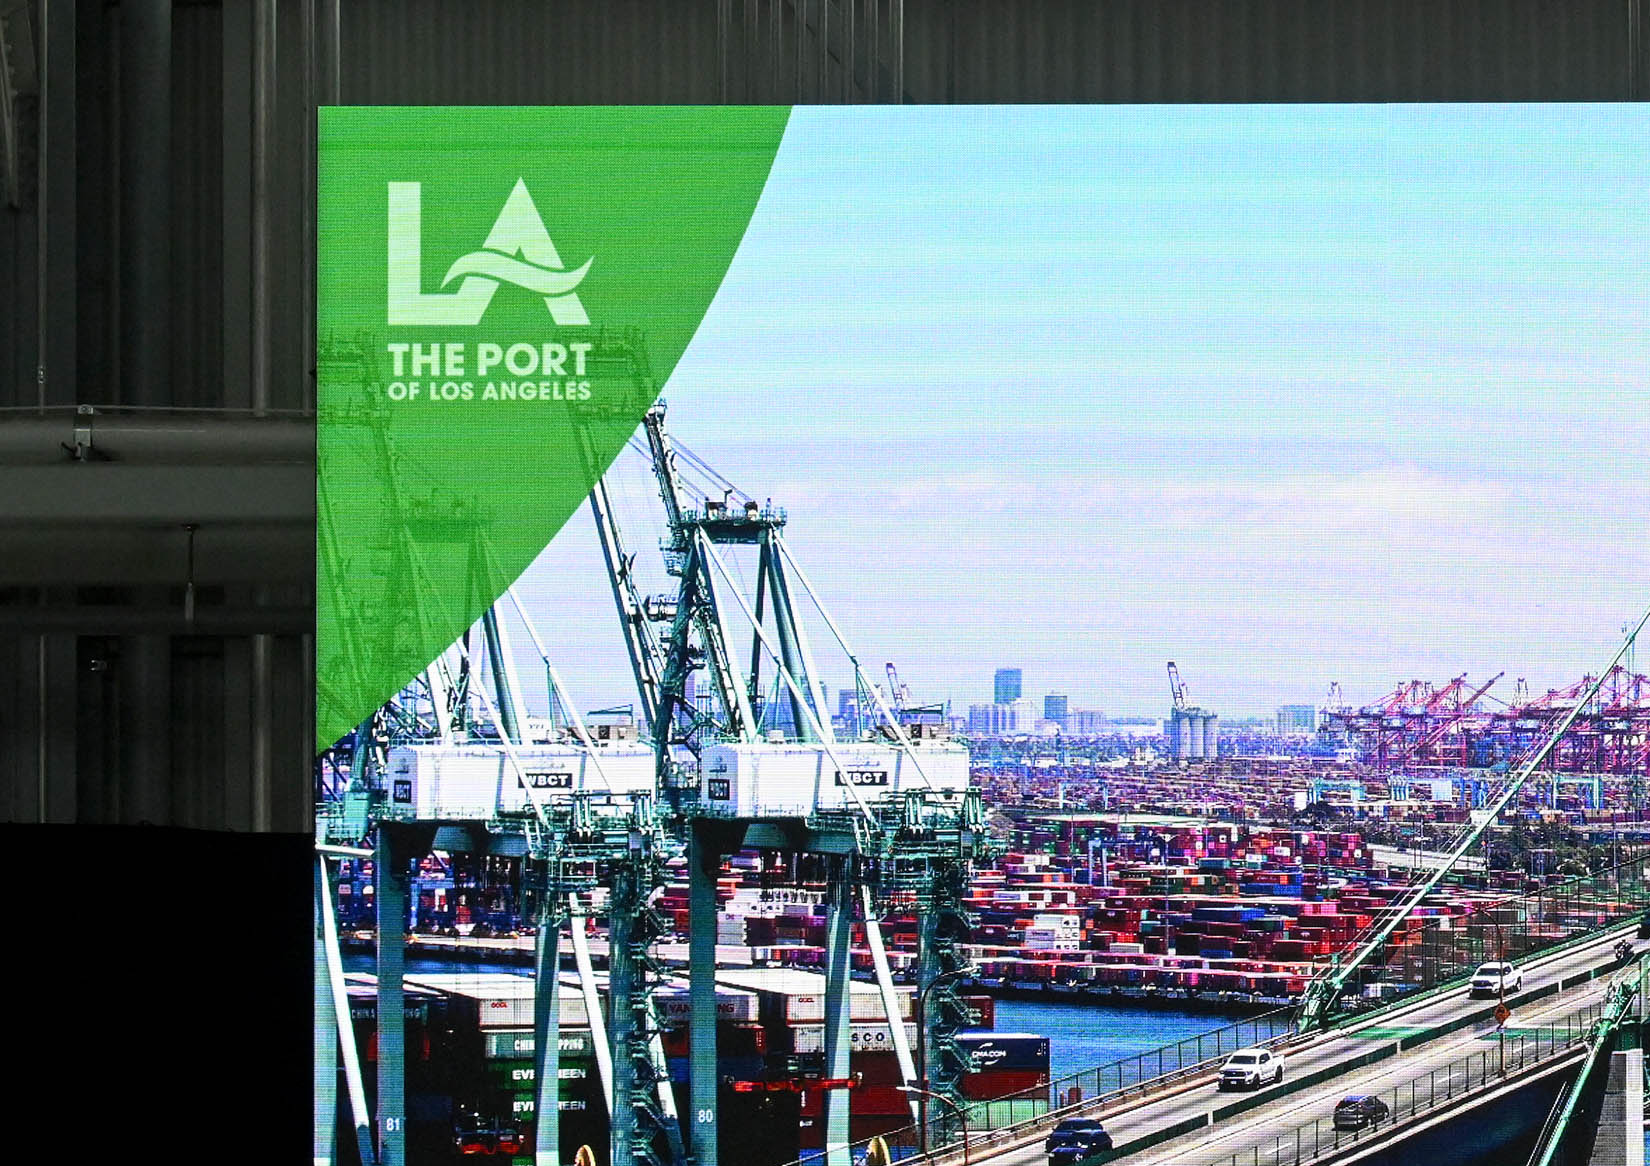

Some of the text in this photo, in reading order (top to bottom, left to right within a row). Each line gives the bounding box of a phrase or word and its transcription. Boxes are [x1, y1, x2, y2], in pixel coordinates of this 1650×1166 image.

[388, 176, 593, 325] LA
[387, 343, 592, 377] THE PORT
[387, 381, 592, 401] OF LOS ANGELES
[386, 1118, 400, 1131] 81
[698, 1109, 713, 1123] 80
